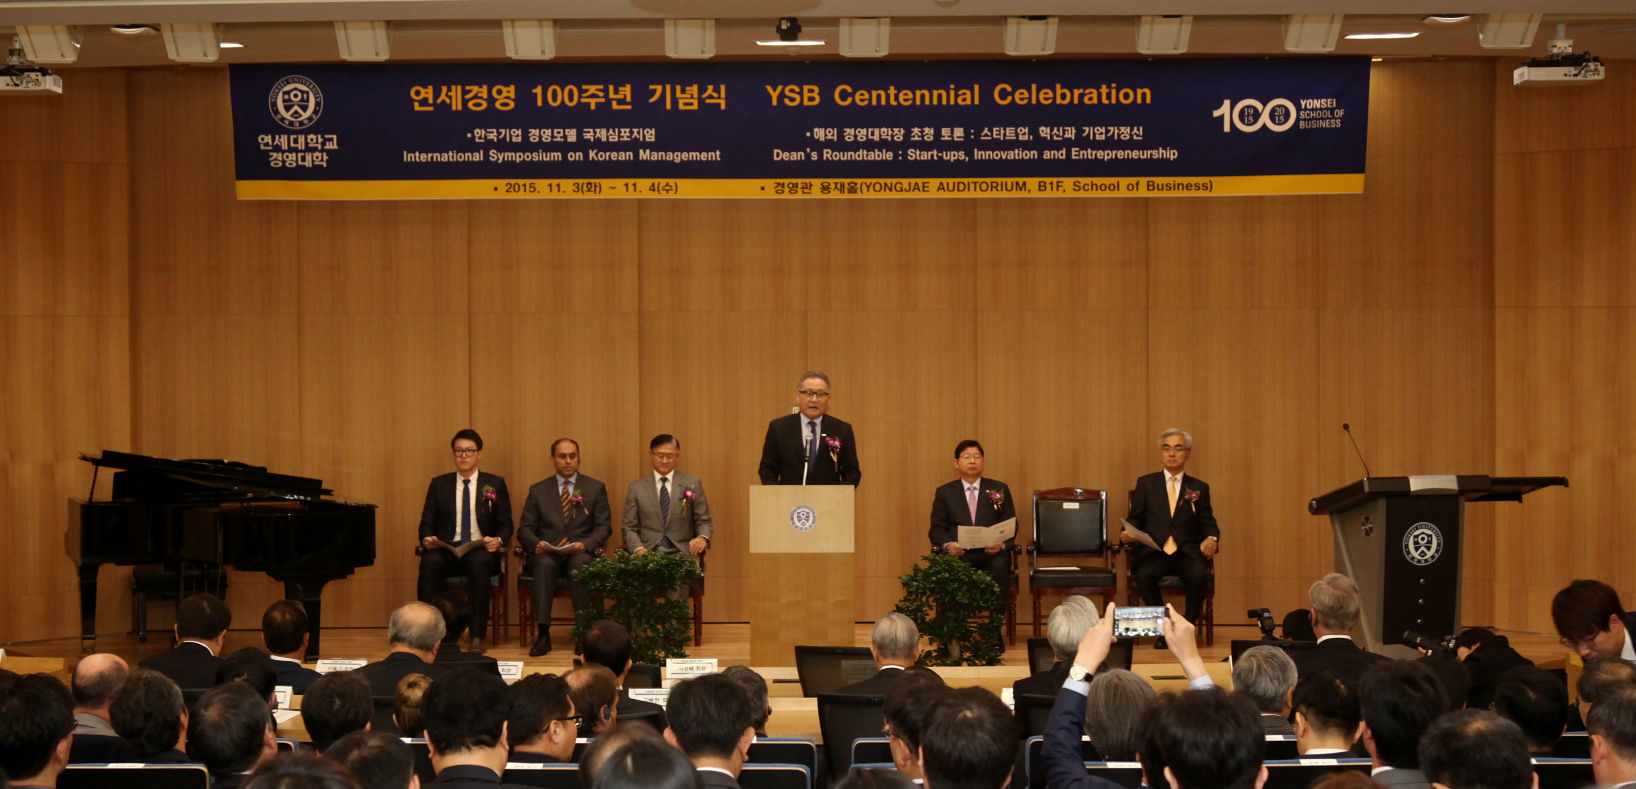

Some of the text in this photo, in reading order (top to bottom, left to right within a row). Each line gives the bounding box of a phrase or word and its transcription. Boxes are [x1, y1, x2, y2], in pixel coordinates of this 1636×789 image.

[409, 84, 726, 111] 연세경영 100주년 기념식
[765, 83, 1152, 106] YSB Centennial Celebration
[1274, 106, 1285, 115] 20
[1300, 98, 1337, 109] YONSEI
[1212, 97, 1298, 133] 100
[1244, 107, 1254, 115] 19
[1300, 109, 1345, 119] SCHOOL OF
[1244, 116, 1254, 124] 15
[1275, 115, 1285, 124] 15
[1299, 119, 1342, 129] BUSINESS
[474, 128, 656, 142] 한국기업 경영모델 국제심포지엄
[813, 127, 838, 142] 해외
[843, 127, 905, 142] 경영대학장
[910, 127, 934, 142] 초청
[941, 127, 965, 141] 토론
[980, 126, 1033, 140] 스타트업,
[1039, 126, 1076, 140] 혁신과
[1082, 126, 1144, 140] 기업가정신
[257, 133, 339, 150] 연세대학교
[268, 151, 329, 168] 경영대학
[403, 148, 721, 163] International Symposium on Korean Management
[823, 148, 893, 160] Roundtable
[907, 148, 969, 162] Start-ups,
[974, 148, 1038, 160] Innovation
[1043, 148, 1066, 159] and
[1071, 147, 1179, 161] Entrepreneurship
[505, 183, 540, 193] 2015.
[547, 183, 566, 193] 11.
[572, 182, 602, 194] 3(화)
[624, 182, 642, 193] 11.
[648, 182, 678, 194] 4(수)
[773, 180, 1214, 194] 경영관 용재홀(YONGJAE AUDITORIUM, B1F, School of Business)
